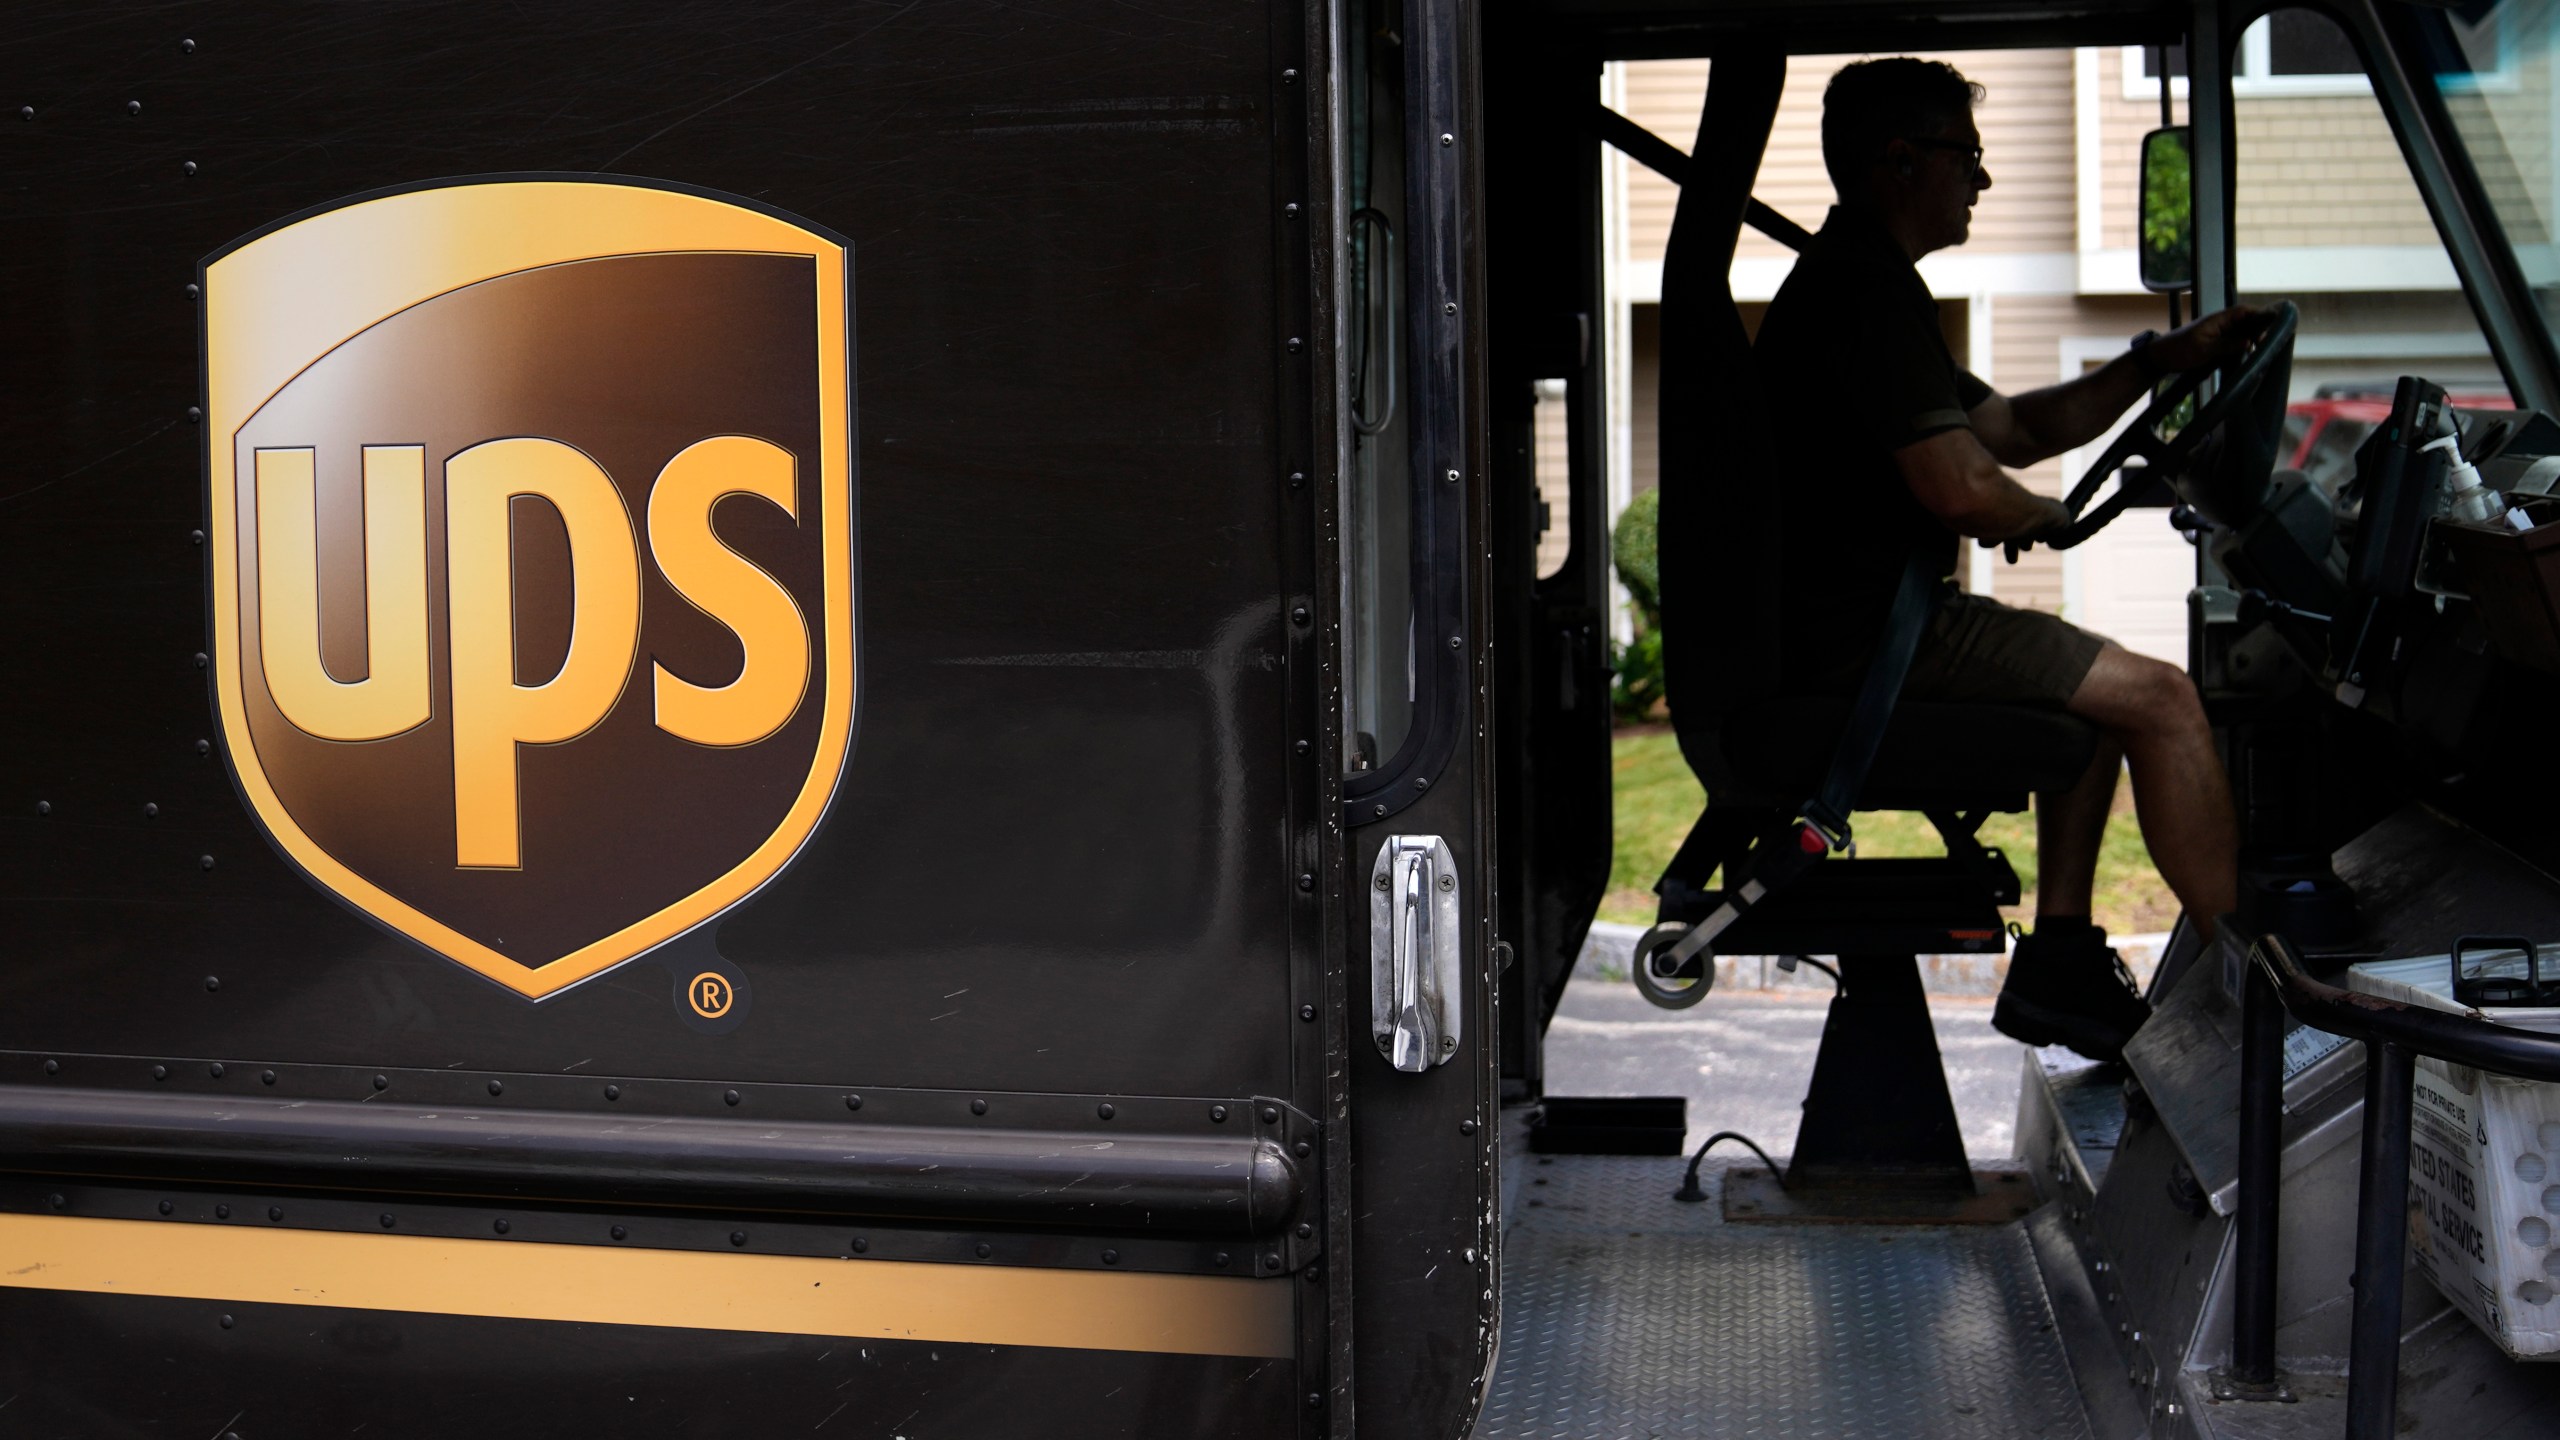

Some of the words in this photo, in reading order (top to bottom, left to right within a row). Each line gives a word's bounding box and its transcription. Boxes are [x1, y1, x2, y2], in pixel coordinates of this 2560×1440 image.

[253, 437, 811, 870] ups
[2428, 1089, 2439, 1107] FOR
[2438, 1094, 2456, 1118] PRIVATE
[2456, 1105, 2466, 1124] USE
[2409, 1141, 2436, 1181] NITED
[2438, 1157, 2475, 1211] STATES
[2408, 1178, 2440, 1227] OSTAL
[2441, 1202, 2485, 1264] SERVICE
